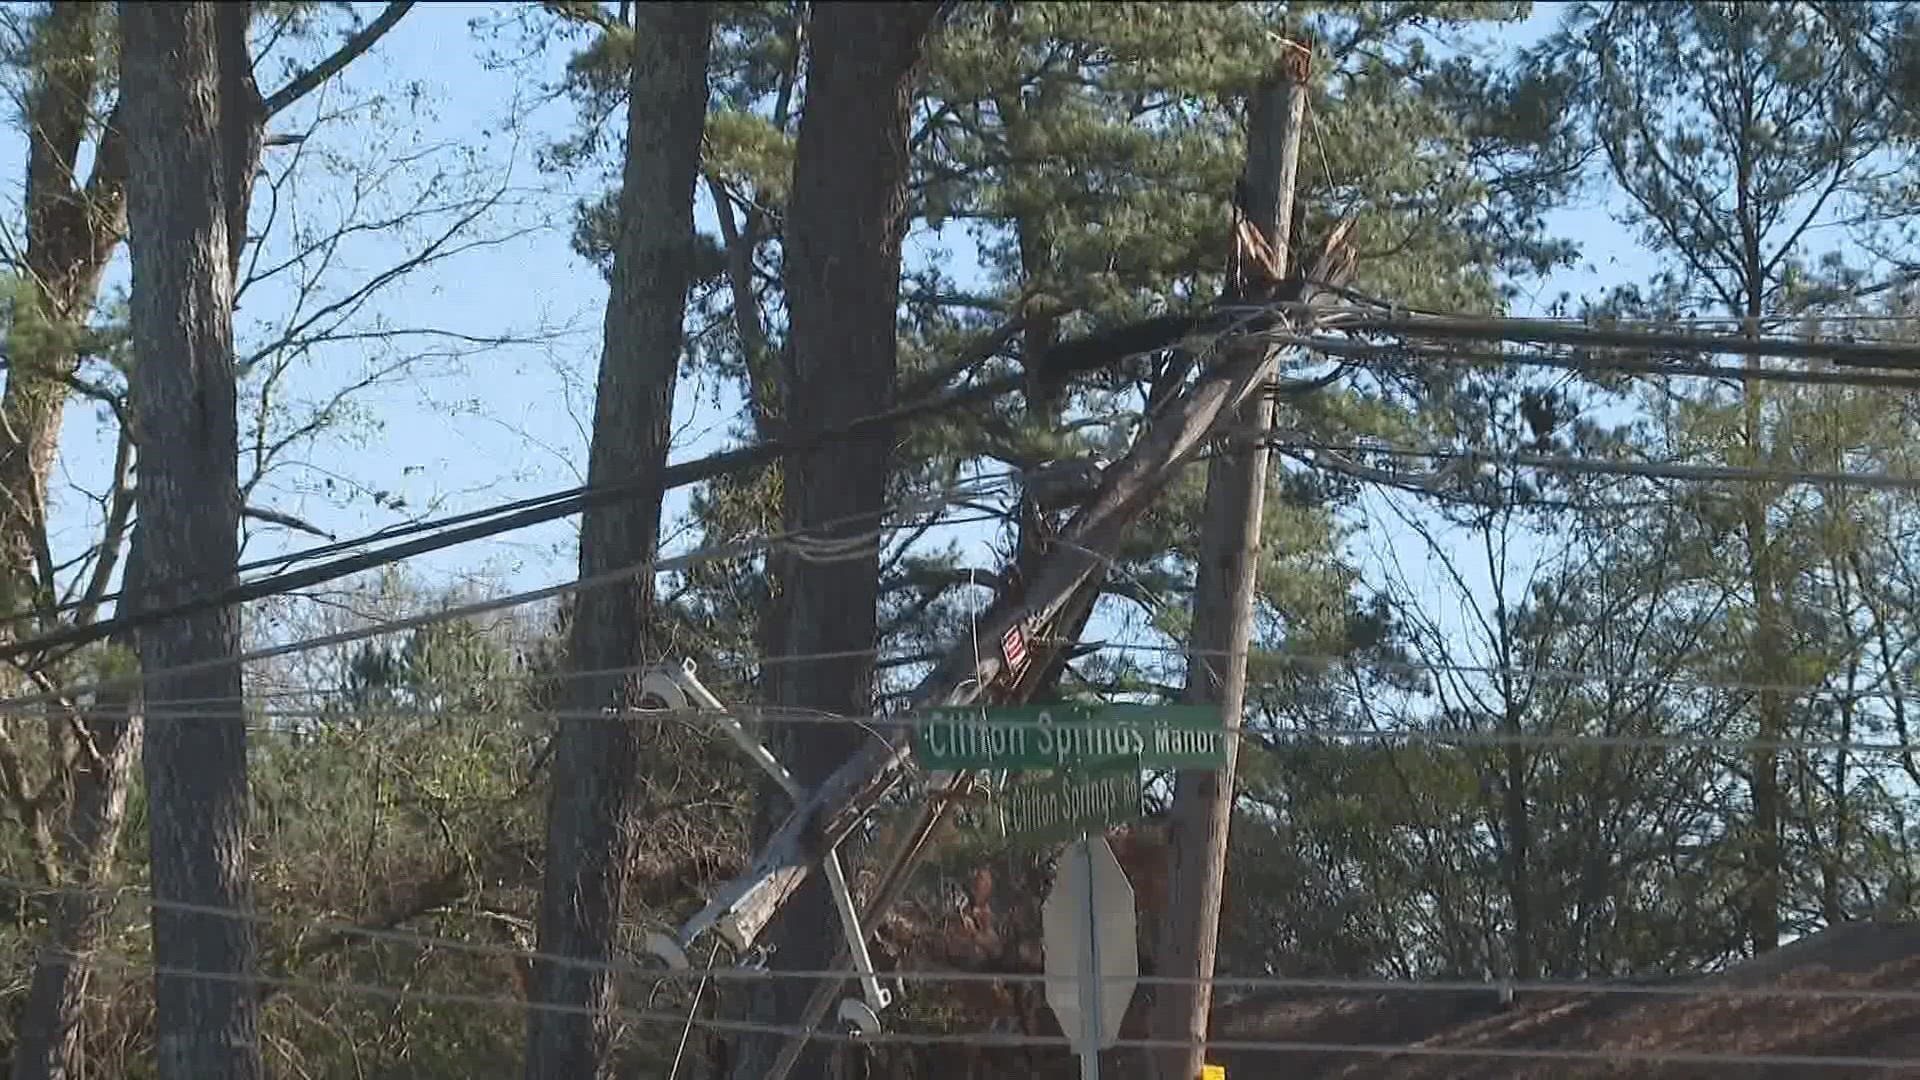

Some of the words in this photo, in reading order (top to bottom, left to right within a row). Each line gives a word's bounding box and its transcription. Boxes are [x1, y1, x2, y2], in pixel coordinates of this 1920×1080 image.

[928, 712, 1025, 756] Clifton
[1037, 711, 1145, 764] Springs
[1155, 721, 1217, 754] Manor
[1013, 786, 1057, 832] Clifton
[1062, 775, 1116, 832] Springs
